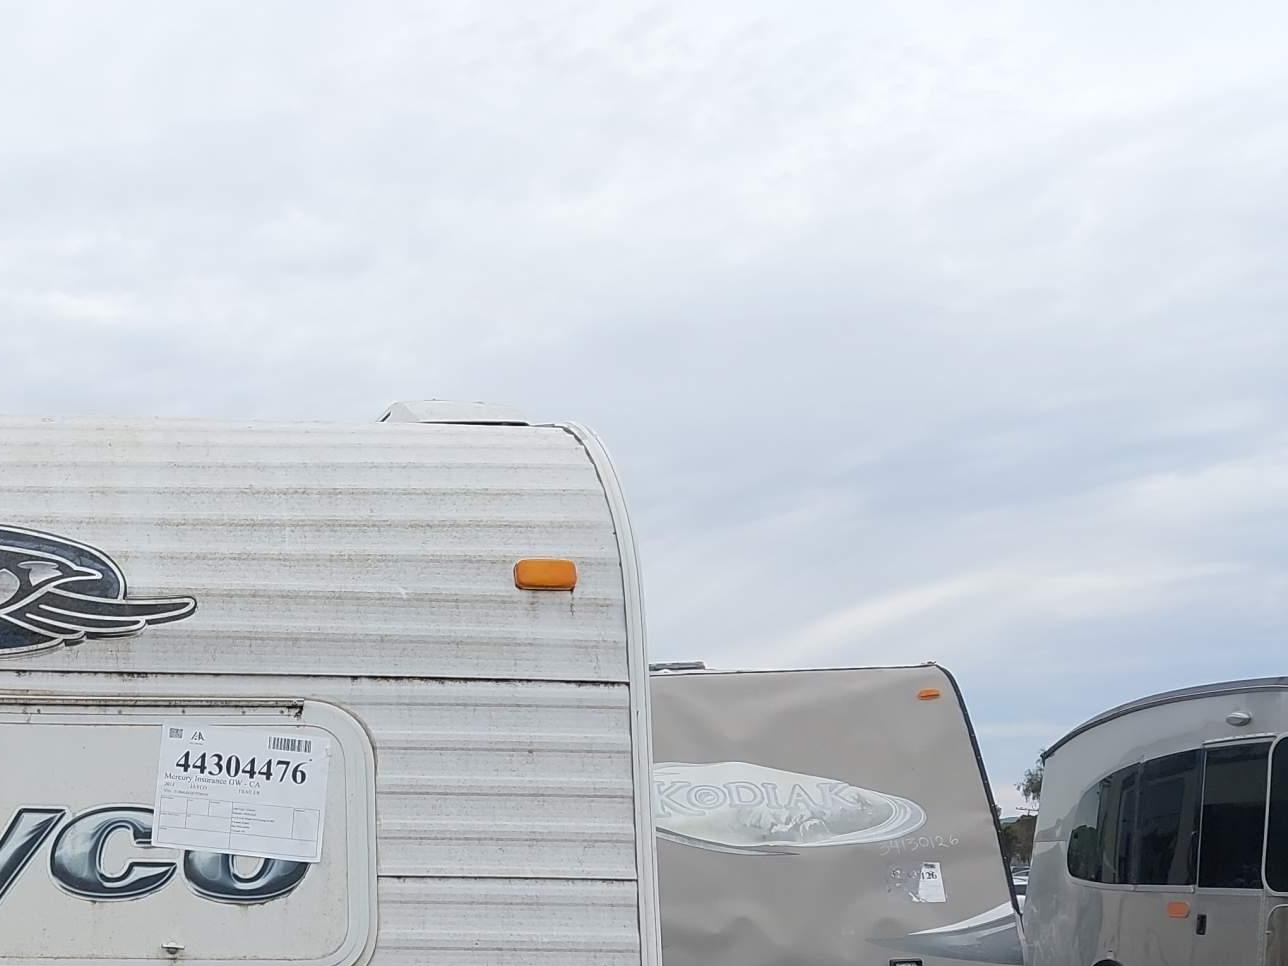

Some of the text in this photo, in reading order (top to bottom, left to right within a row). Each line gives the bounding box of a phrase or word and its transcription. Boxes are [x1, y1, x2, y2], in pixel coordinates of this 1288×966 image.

[164, 772, 192, 783] Mercury
[194, 775, 227, 785] Insurance
[175, 750, 307, 785] 44304476
[654, 780, 855, 818] KODIAK
